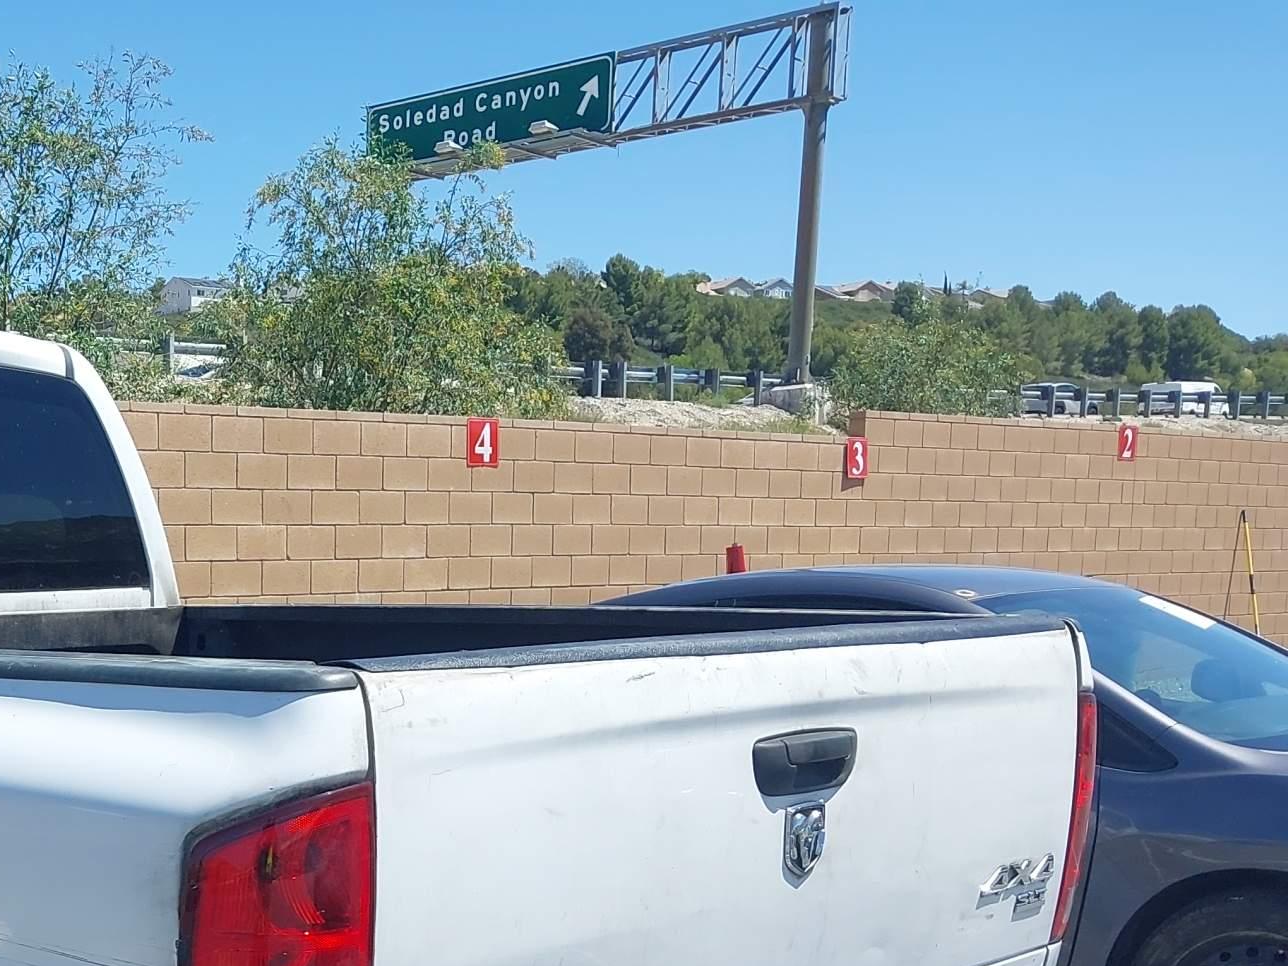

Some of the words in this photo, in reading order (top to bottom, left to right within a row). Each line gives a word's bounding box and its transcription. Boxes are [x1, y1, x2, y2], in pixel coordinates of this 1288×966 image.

[378, 97, 464, 133] Soledad
[475, 81, 561, 112] Canyon
[474, 422, 493, 463] 4
[852, 441, 864, 475] 3
[1122, 428, 1133, 458] 2
